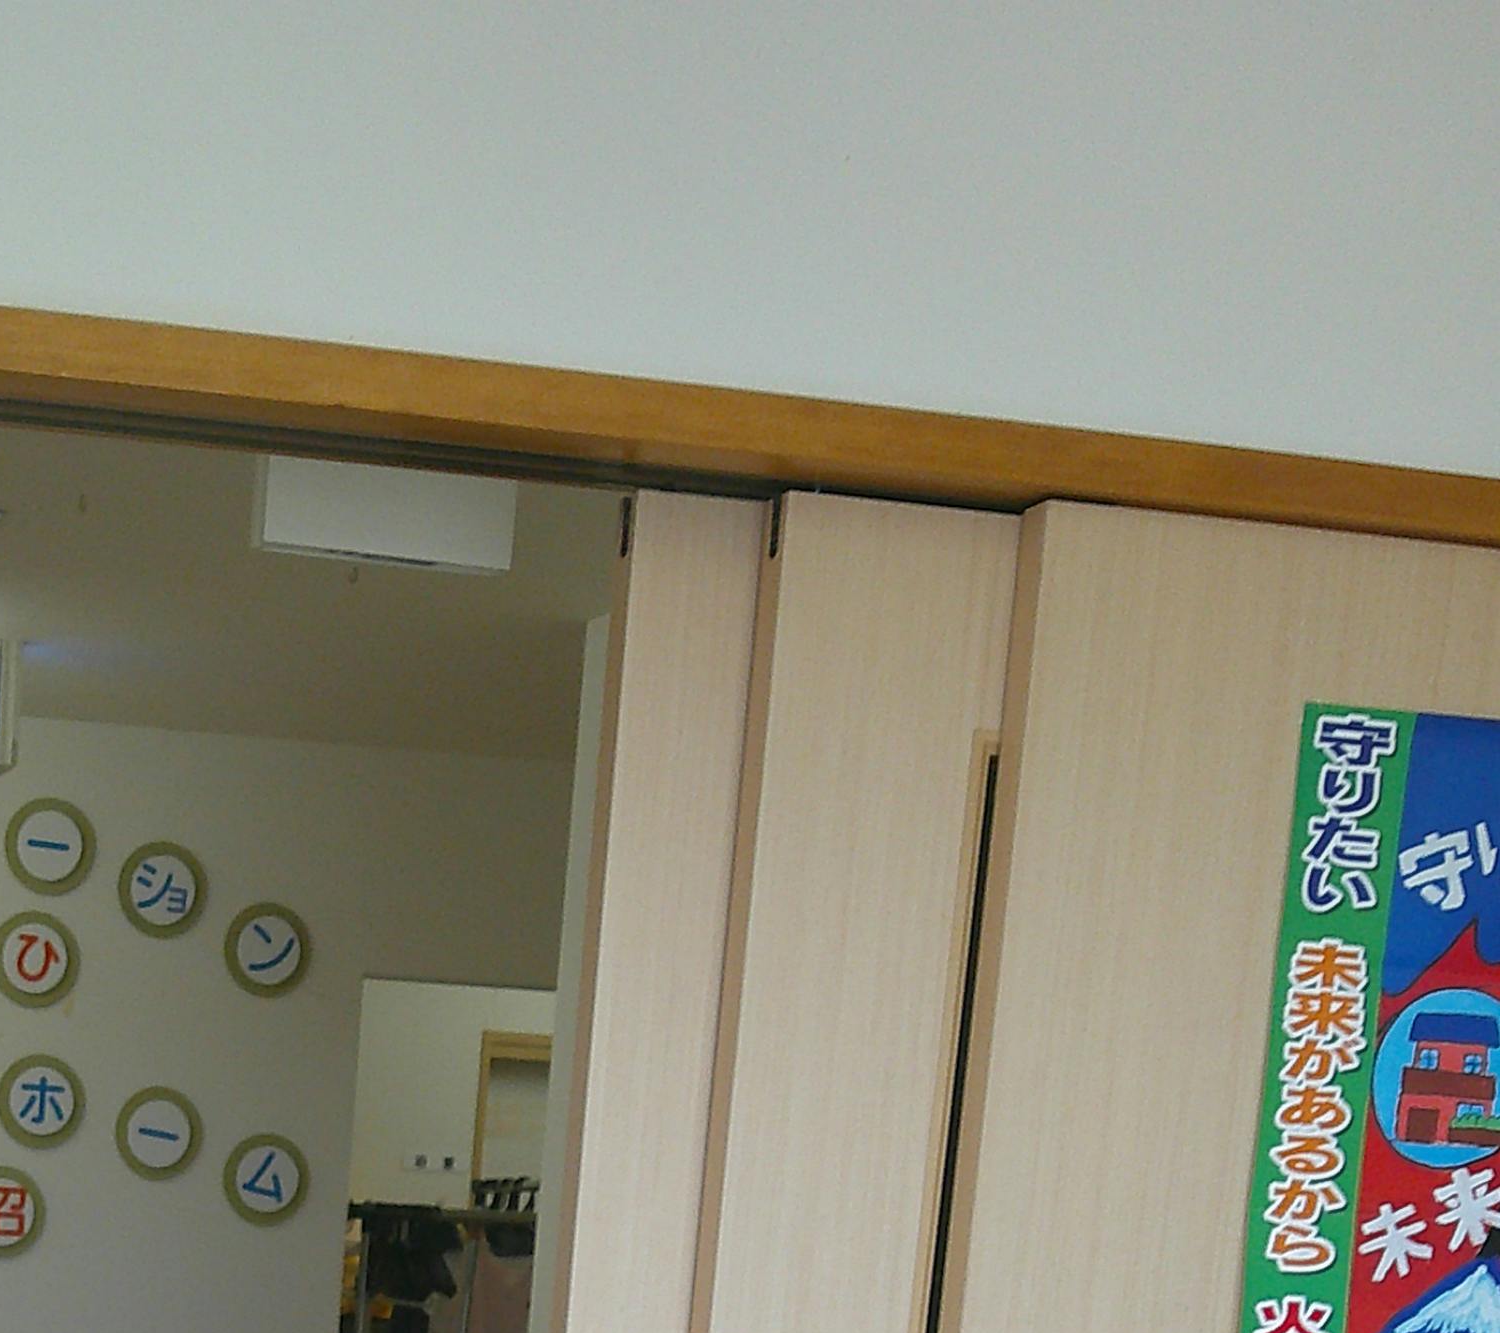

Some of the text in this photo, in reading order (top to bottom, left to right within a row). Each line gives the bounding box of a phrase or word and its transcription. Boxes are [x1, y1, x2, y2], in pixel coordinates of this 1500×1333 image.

[1302, 714, 1397, 912] 守りたい
[1264, 937, 1370, 1274] 未来があるから
